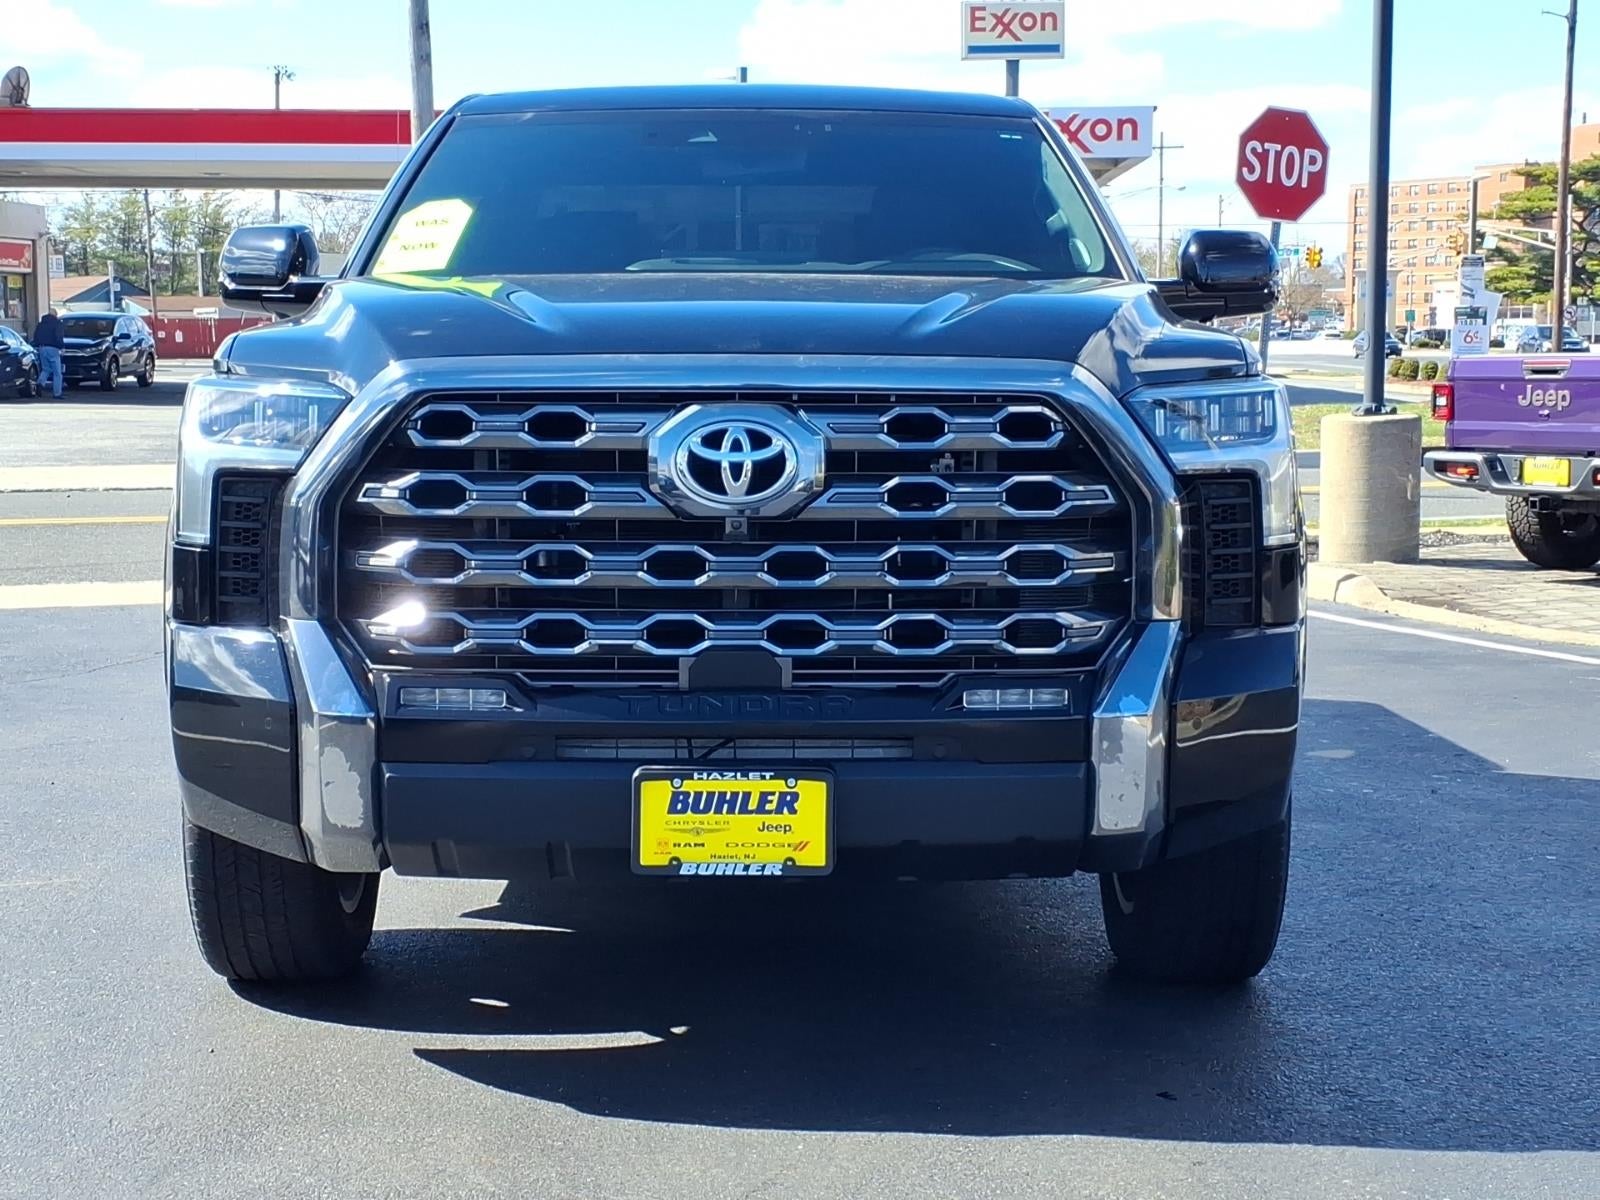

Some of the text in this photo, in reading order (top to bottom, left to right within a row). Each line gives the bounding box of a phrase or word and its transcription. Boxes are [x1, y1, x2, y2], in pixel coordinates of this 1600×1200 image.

[970, 6, 1058, 42] Exxon
[1043, 111, 1139, 154] xxon
[1241, 140, 1323, 188] STOP
[1517, 384, 1571, 411] Jeep
[617, 695, 854, 716] TUNDRA
[693, 772, 775, 780] HAZLET
[666, 790, 800, 815] BUHLER
[757, 821, 793, 834] Jeep
[679, 863, 783, 876] BUHLER
